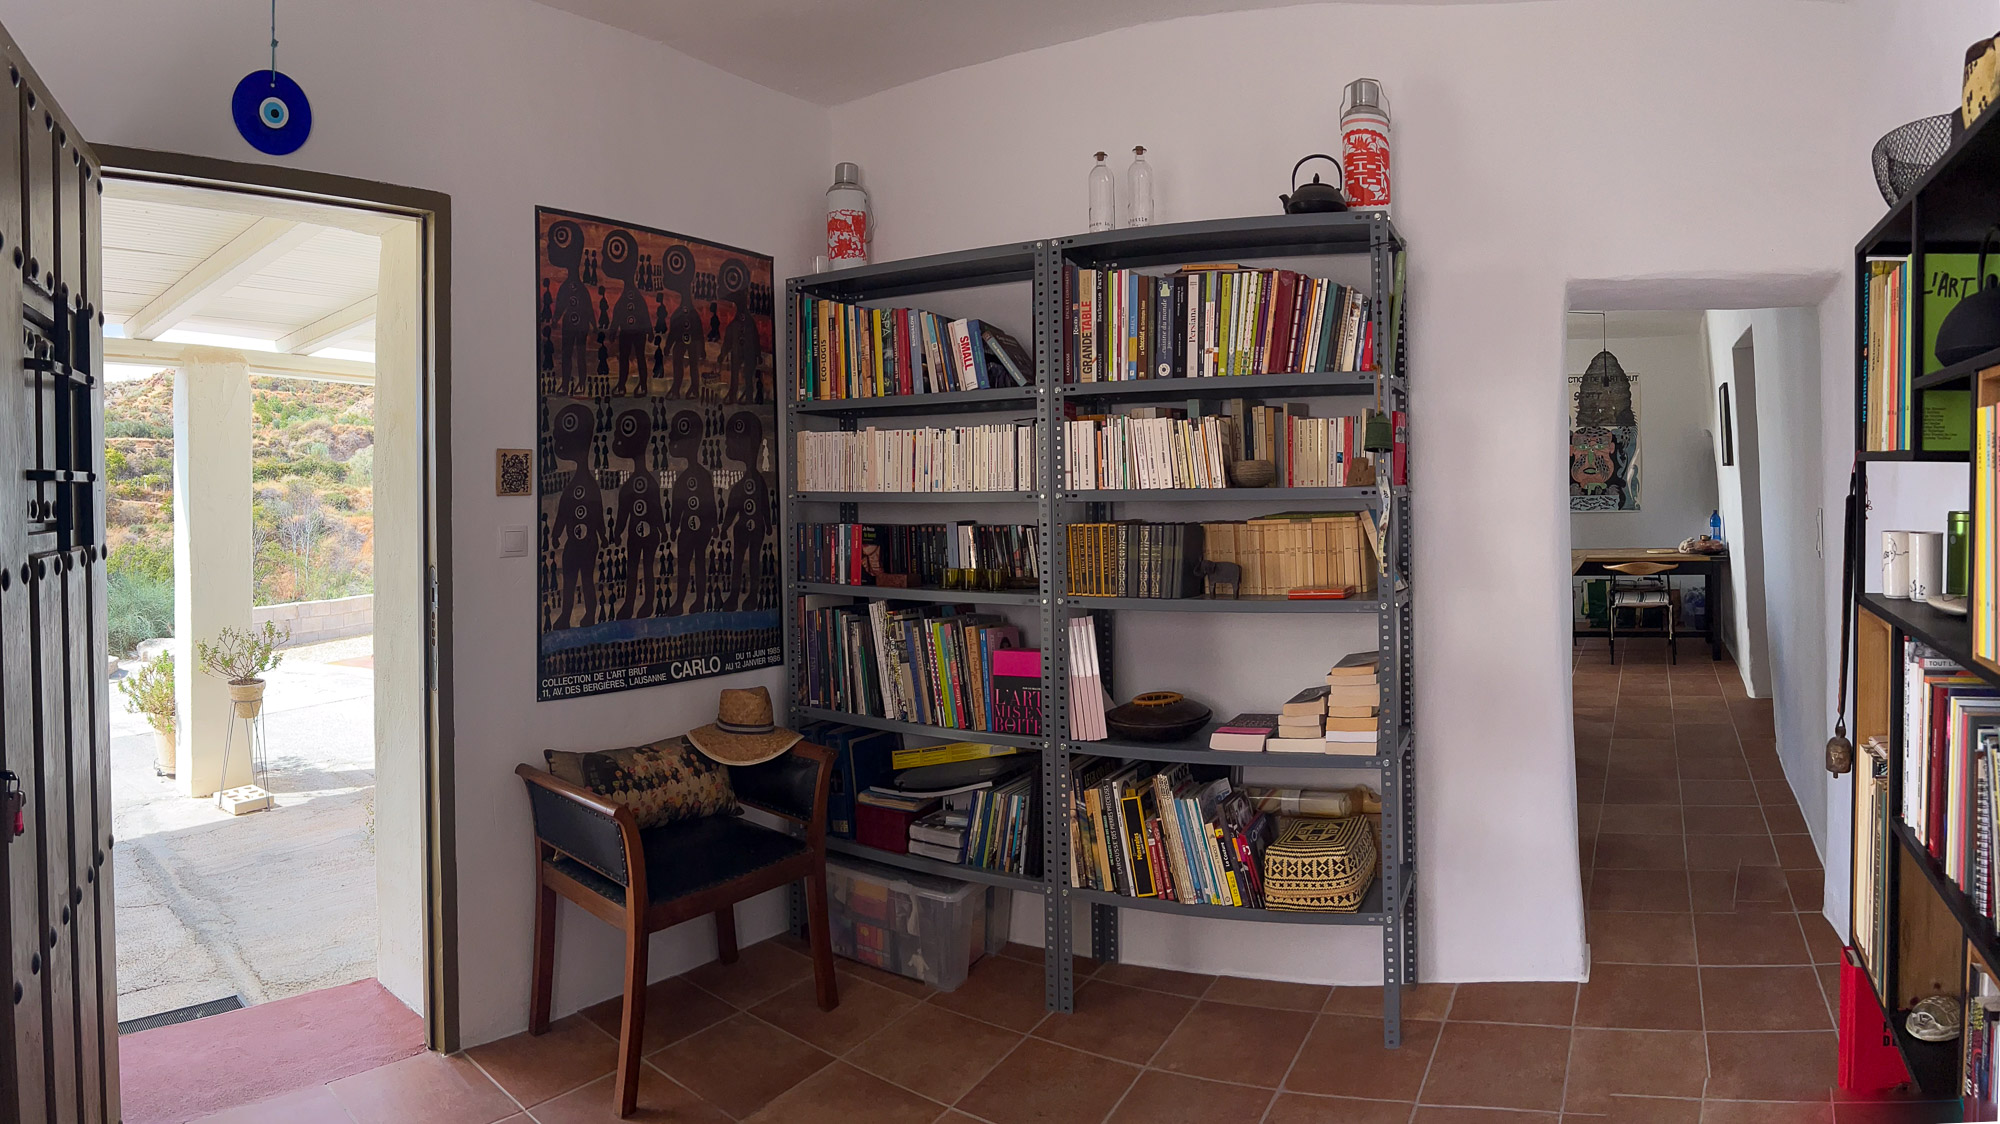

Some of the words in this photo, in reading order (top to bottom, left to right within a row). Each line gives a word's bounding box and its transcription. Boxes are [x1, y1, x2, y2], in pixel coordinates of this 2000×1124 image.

[881, 312, 892, 337] SPA
[1189, 308, 1197, 343] Persiana
[960, 336, 973, 371] SMALL
[725, 663, 734, 671] AU
[735, 661, 741, 669] 12
[742, 657, 766, 668] JANVIER
[736, 652, 745, 660] DU
[753, 649, 766, 658] JUIN
[542, 674, 591, 688] COLLECTION
[594, 672, 604, 680] DE
[606, 669, 627, 680] L'ART
[628, 667, 648, 677] BRUT
[670, 656, 721, 679] CARLO
[542, 689, 551, 698] 11,
[553, 688, 564, 697] AV.
[565, 685, 581, 695] DES
[583, 678, 628, 693] BERGIÈRES,
[629, 673, 667, 686] LAUSANNE
[995, 688, 1041, 707] L'ART
[995, 705, 1021, 719] MIS
[1114, 841, 1123, 875] LAROUSSE
[1220, 842, 1230, 859] Couture
